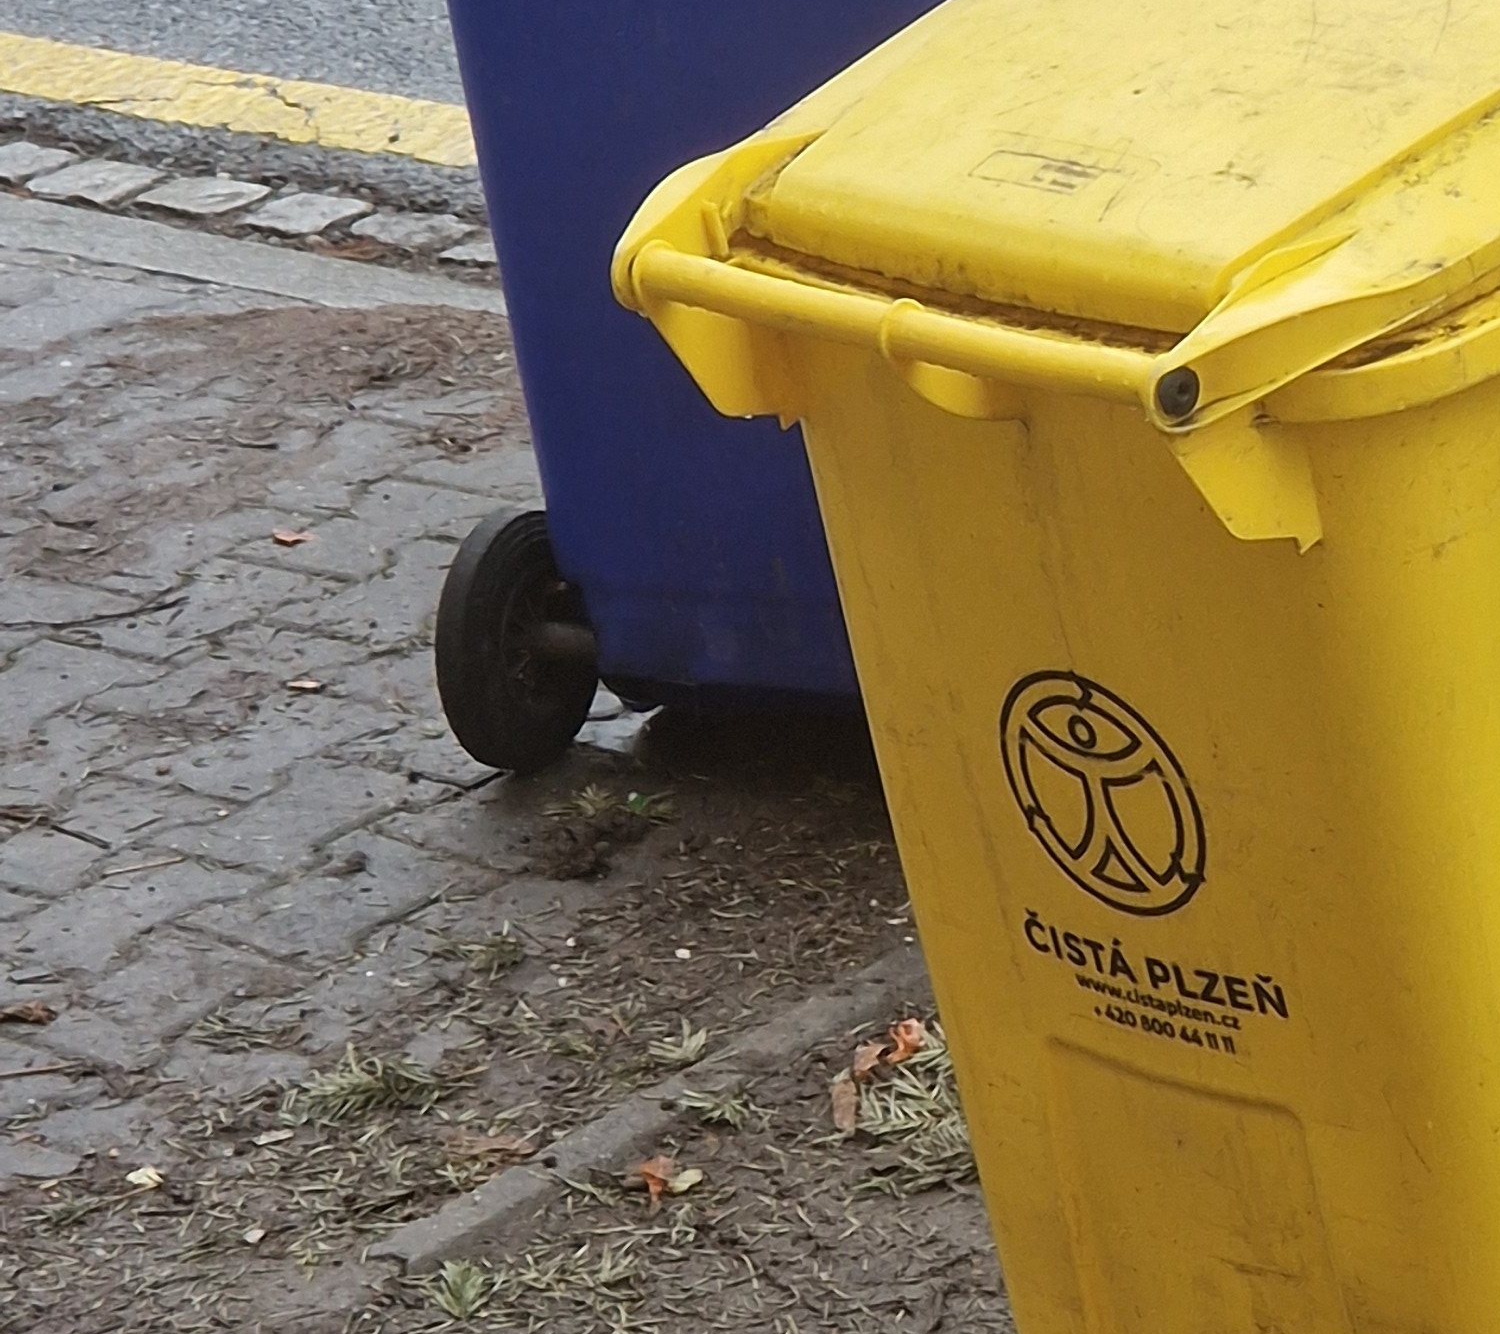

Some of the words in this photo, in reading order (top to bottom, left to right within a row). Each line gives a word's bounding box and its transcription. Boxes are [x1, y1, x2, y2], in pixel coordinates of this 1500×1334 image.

[1023, 907, 1138, 984] ČISTÁ
[1145, 956, 1289, 1019] PLZEŇ
[1075, 973, 1241, 1030] www.cistaplzen.cz
[1140, 1014, 1176, 1038] 800
[1179, 1025, 1203, 1047] 44
